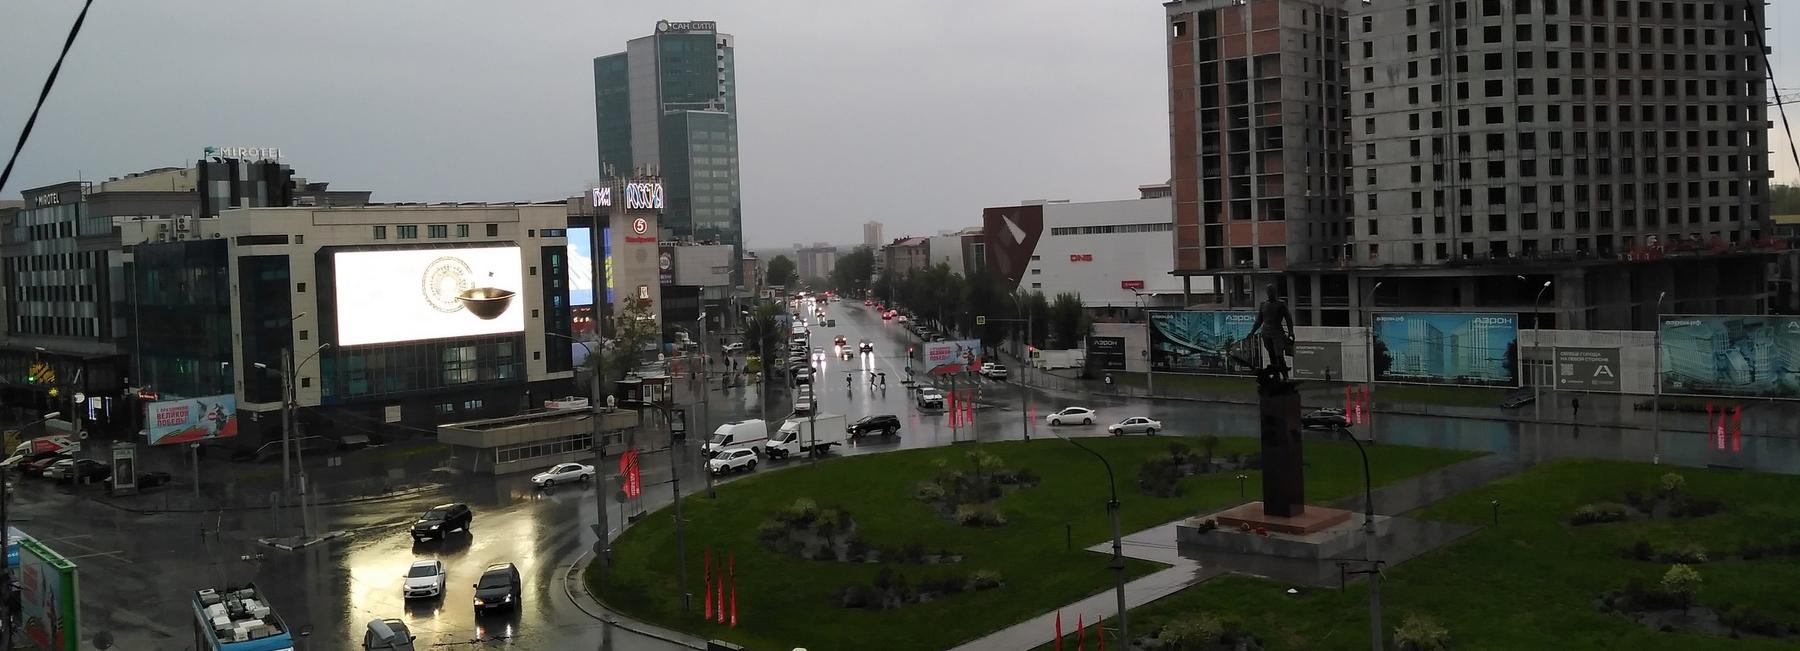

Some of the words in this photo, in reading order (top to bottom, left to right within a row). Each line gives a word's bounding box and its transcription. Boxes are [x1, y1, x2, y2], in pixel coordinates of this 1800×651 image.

[220, 147, 284, 157] MIROTEL
[39, 192, 60, 206] MIROTEL
[626, 183, 663, 209] РОССИЯ
[1070, 254, 1093, 262] DNS
